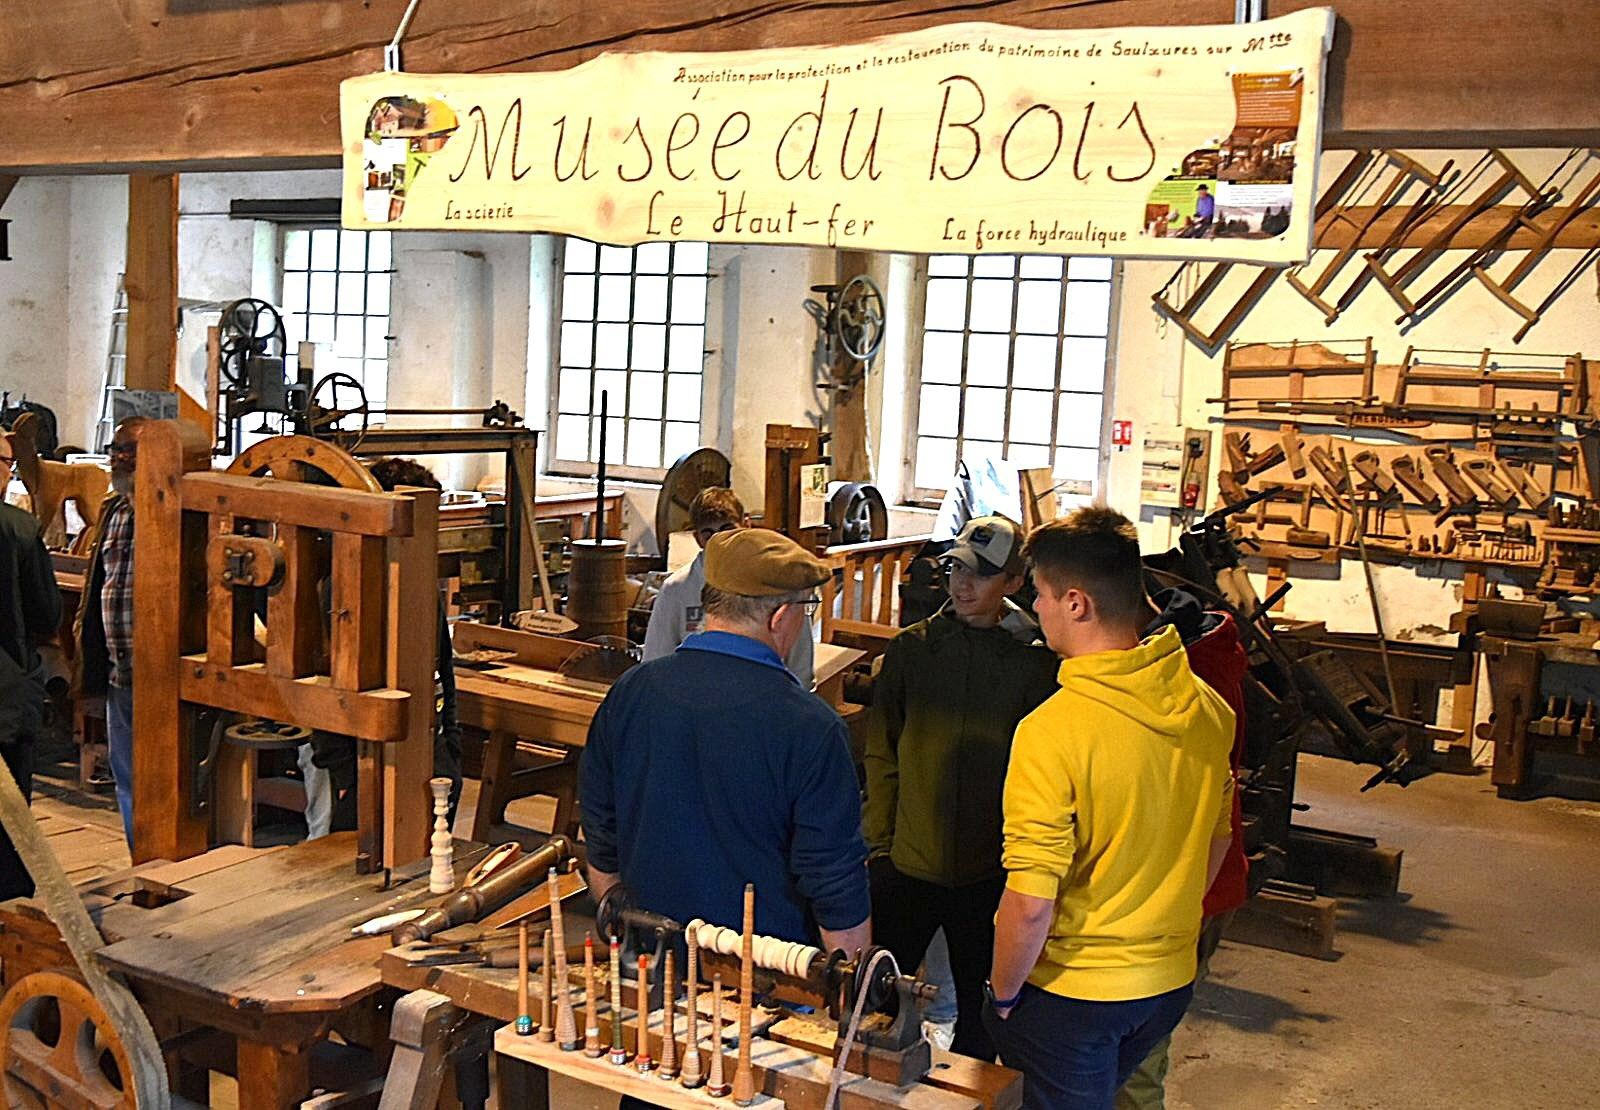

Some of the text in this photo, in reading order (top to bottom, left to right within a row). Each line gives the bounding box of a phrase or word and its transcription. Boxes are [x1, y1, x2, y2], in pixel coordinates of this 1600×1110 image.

[673, 67, 745, 83] Association
[748, 72, 773, 84] pour
[787, 64, 851, 82] protection
[856, 59, 868, 71] et
[887, 41, 970, 65] restauration
[978, 38, 994, 53] du
[999, 44, 1080, 58] patrimoine
[1086, 44, 1102, 57] de
[1111, 40, 1198, 57] Saulxures
[1206, 46, 1233, 55] sur
[449, 75, 1156, 182] Musée du Bois
[445, 200, 514, 220] La scierie
[646, 190, 874, 248] Le Haut-fer
[942, 217, 1127, 250] La force hydraulique
